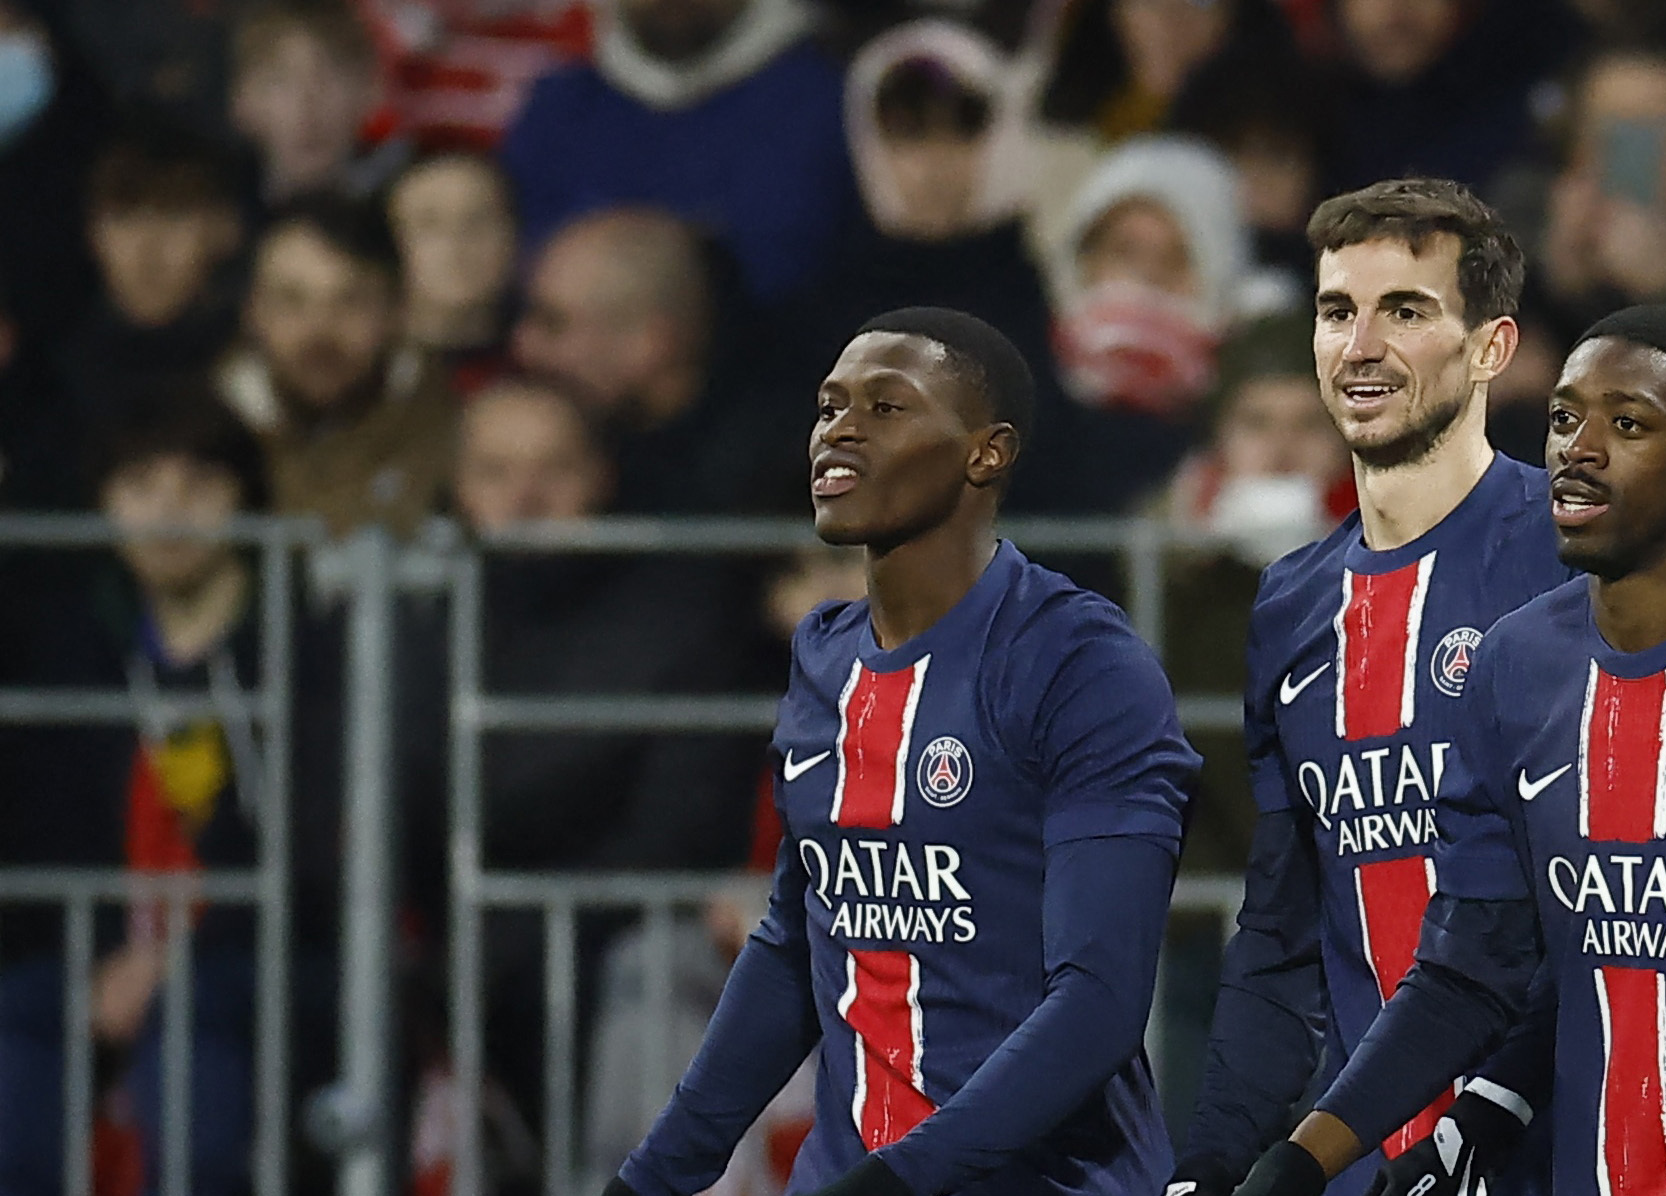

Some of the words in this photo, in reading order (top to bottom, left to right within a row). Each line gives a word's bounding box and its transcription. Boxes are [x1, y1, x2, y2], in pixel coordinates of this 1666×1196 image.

[1444, 631, 1482, 648] PARIS
[928, 740, 963, 758] PARIS
[1338, 808, 1439, 857] AIRWA
[799, 838, 972, 910] QATAR
[830, 902, 976, 942] AIRWAYS
